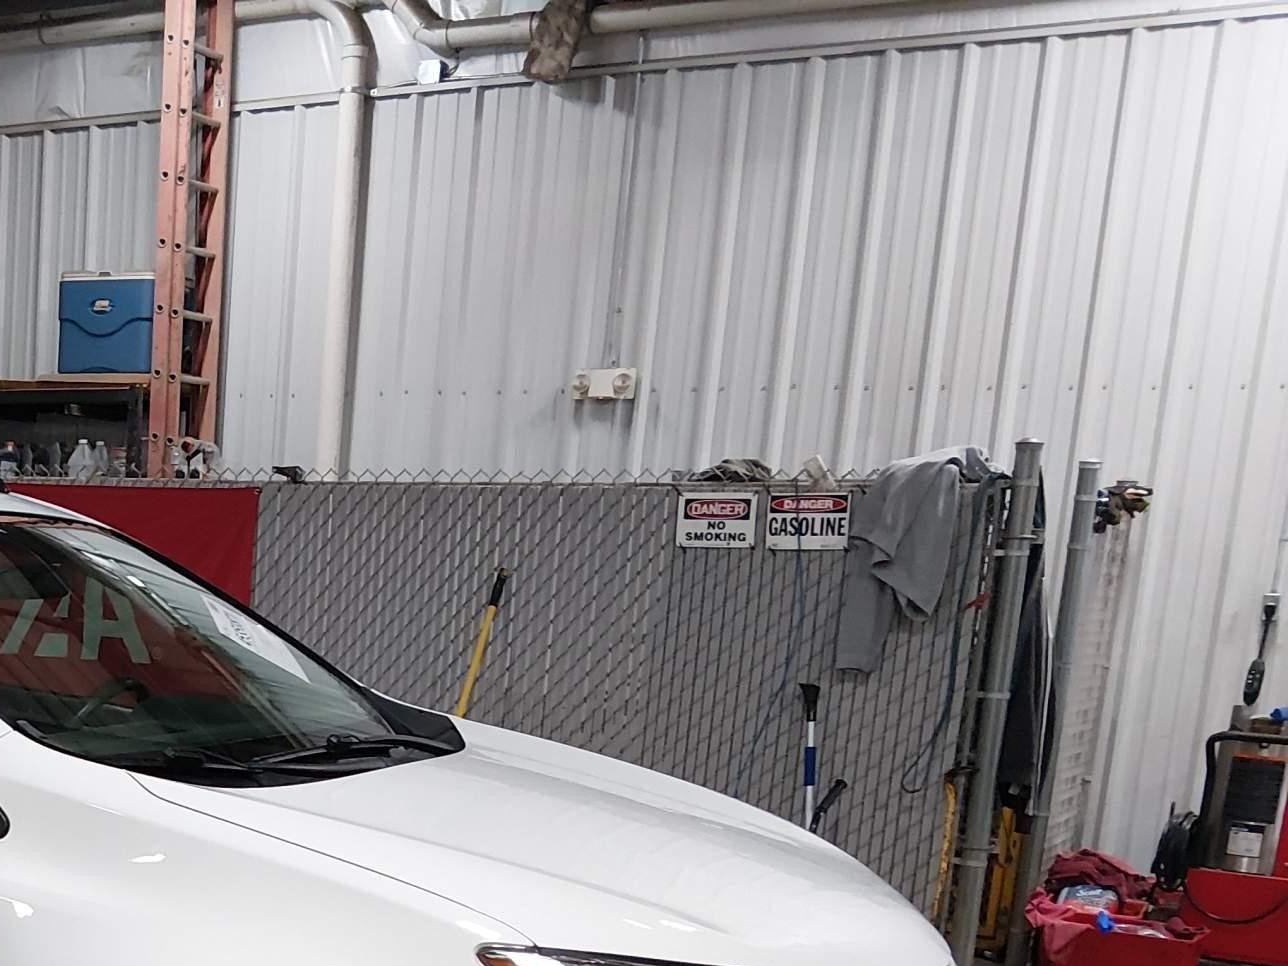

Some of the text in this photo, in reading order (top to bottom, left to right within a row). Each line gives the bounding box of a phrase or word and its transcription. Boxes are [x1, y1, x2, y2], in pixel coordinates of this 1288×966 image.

[691, 503, 744, 515] DANGER
[707, 520, 726, 530] NO
[768, 516, 846, 537] GASOLINE
[685, 531, 746, 542] SMOKING
